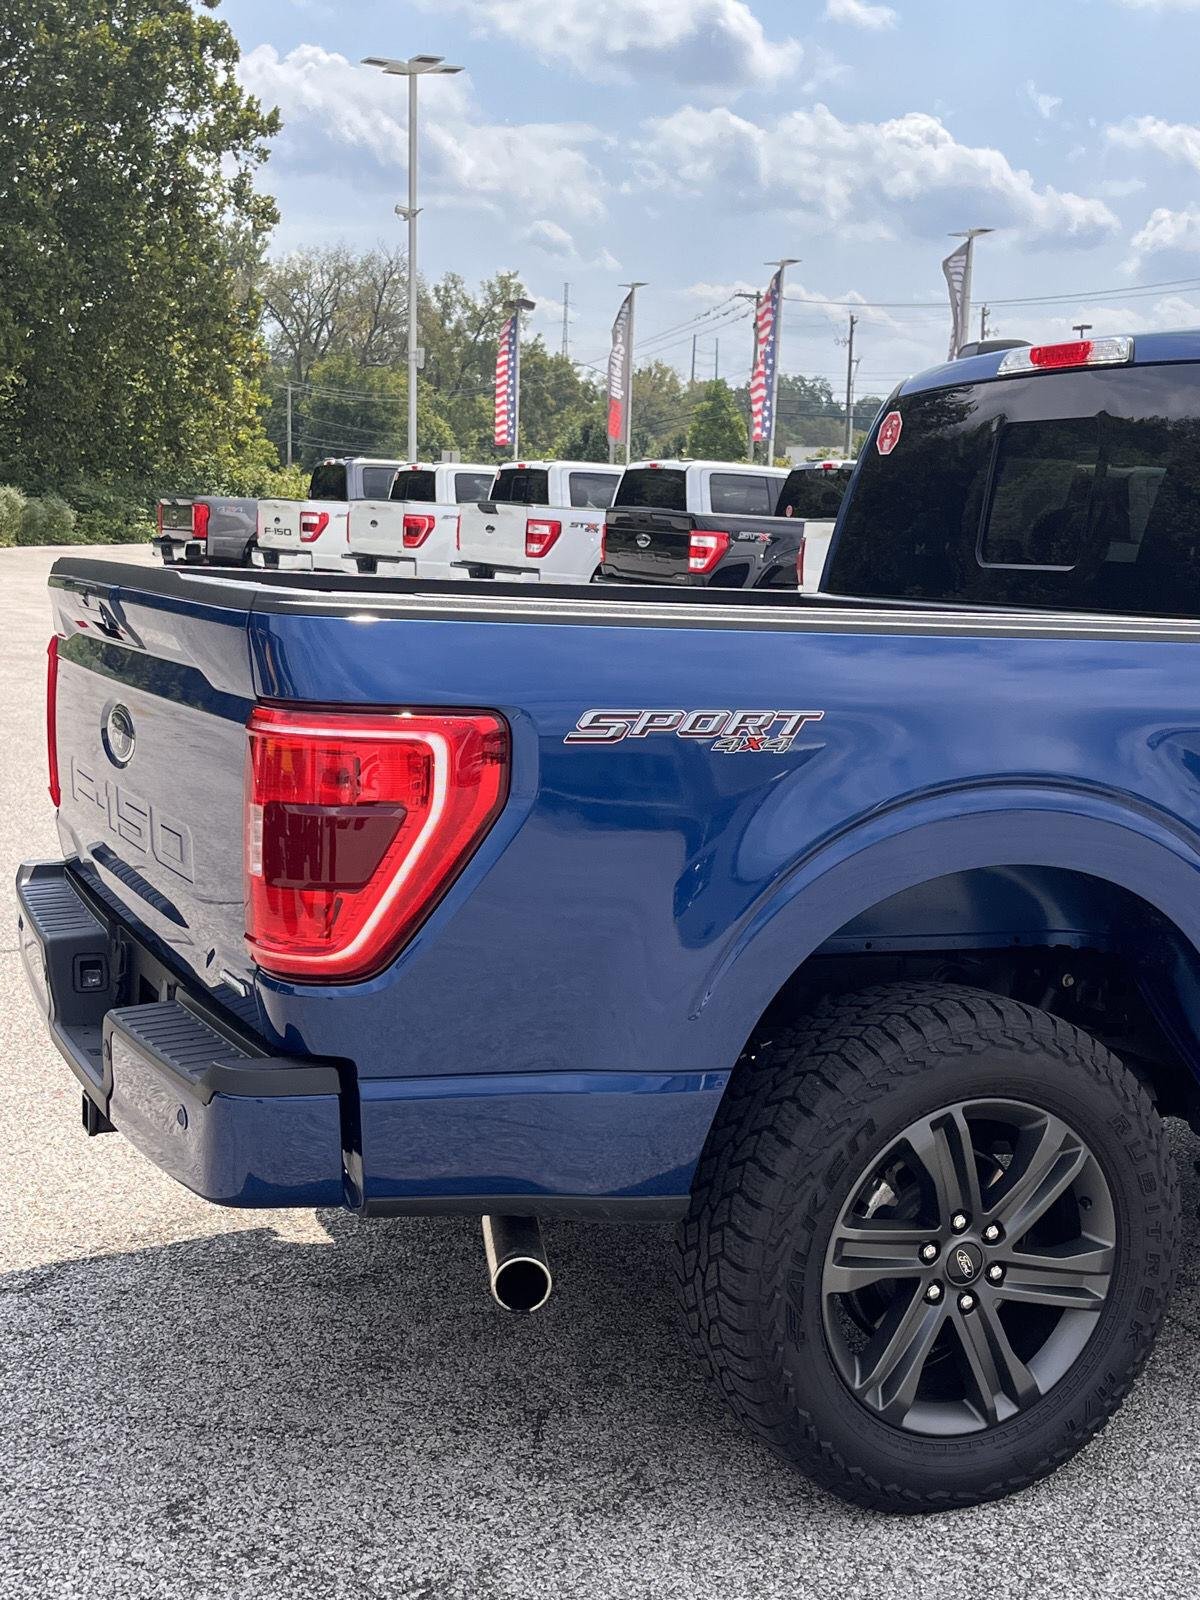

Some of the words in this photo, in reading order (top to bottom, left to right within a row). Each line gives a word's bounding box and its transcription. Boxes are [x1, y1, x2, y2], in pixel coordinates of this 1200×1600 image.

[264, 527, 292, 536] F-150
[563, 709, 825, 744] SPORT
[71, 757, 194, 884] F-150
[1108, 1112, 1162, 1346] RUBITREK
